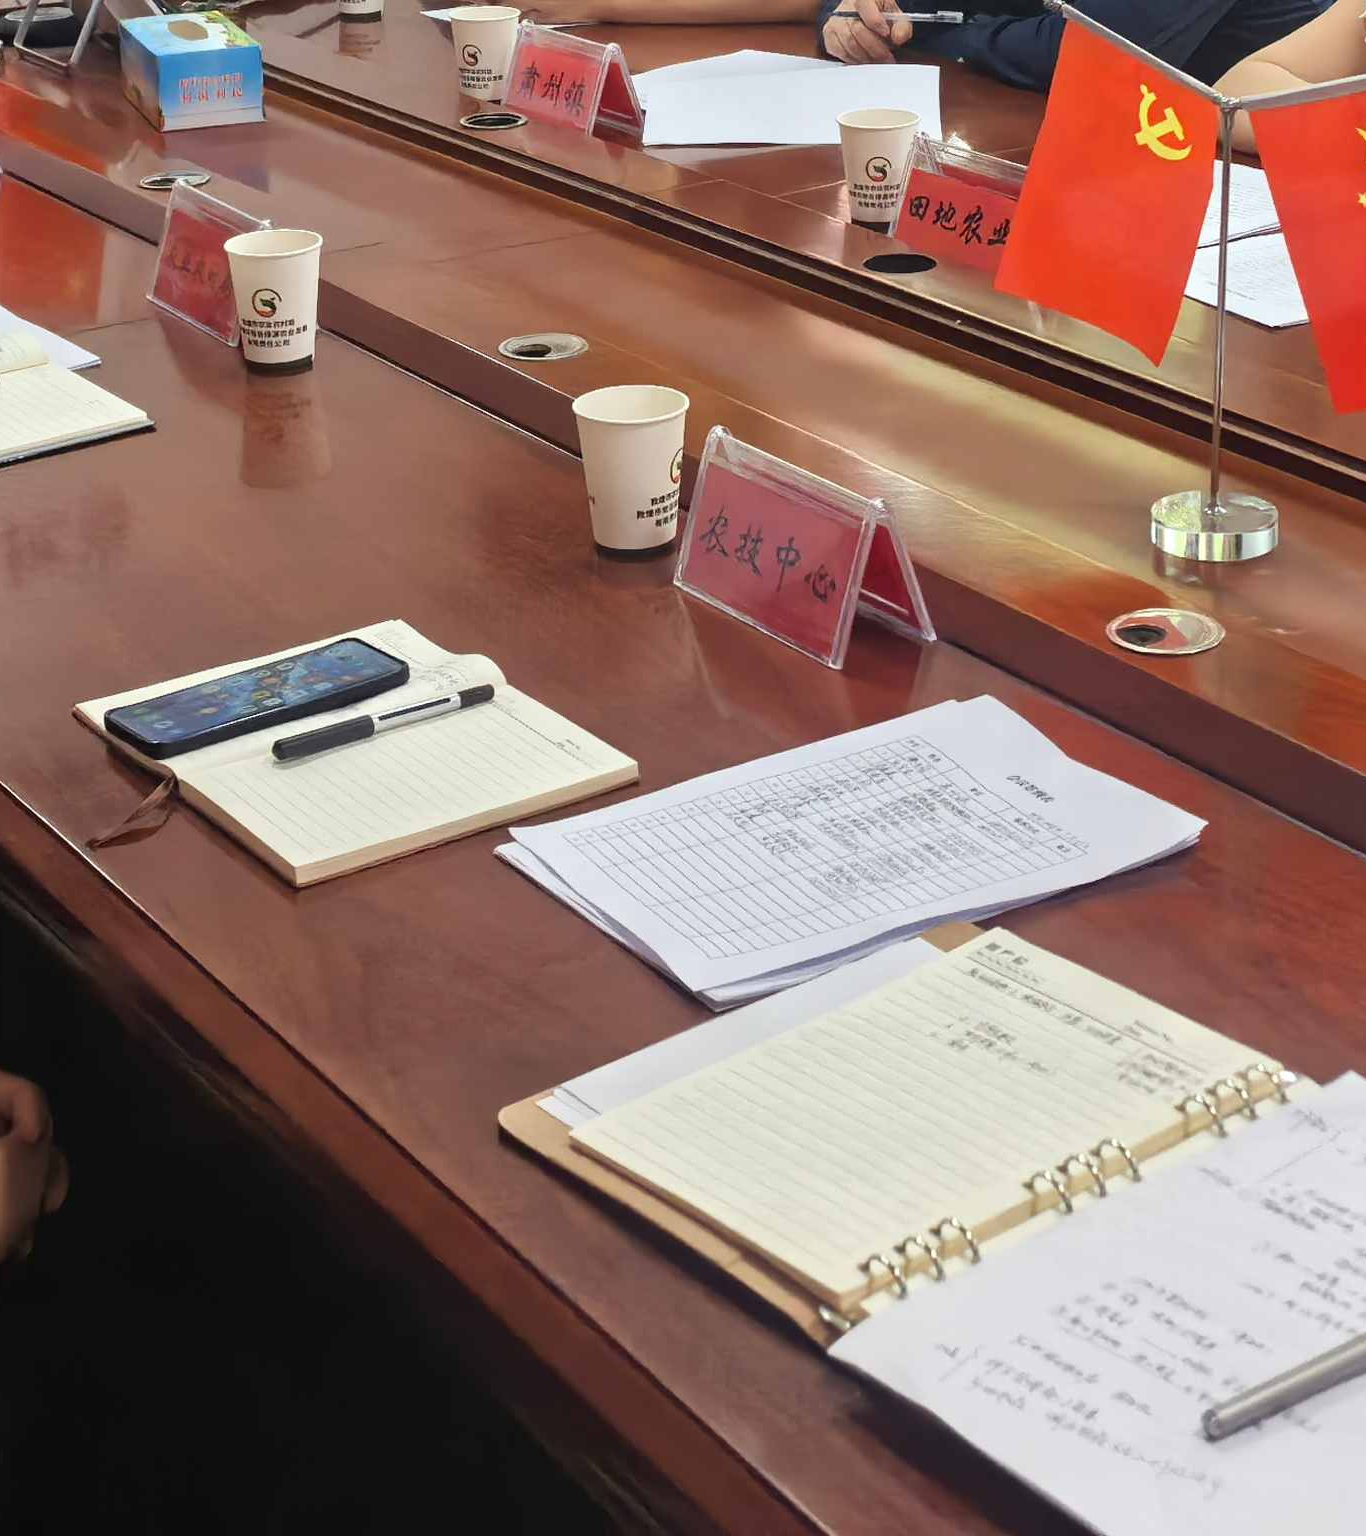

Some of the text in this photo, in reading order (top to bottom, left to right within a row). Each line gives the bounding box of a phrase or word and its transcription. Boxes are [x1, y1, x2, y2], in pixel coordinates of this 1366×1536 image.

[909, 195, 1011, 246] 田地农业
[699, 504, 837, 605] 农技中心
